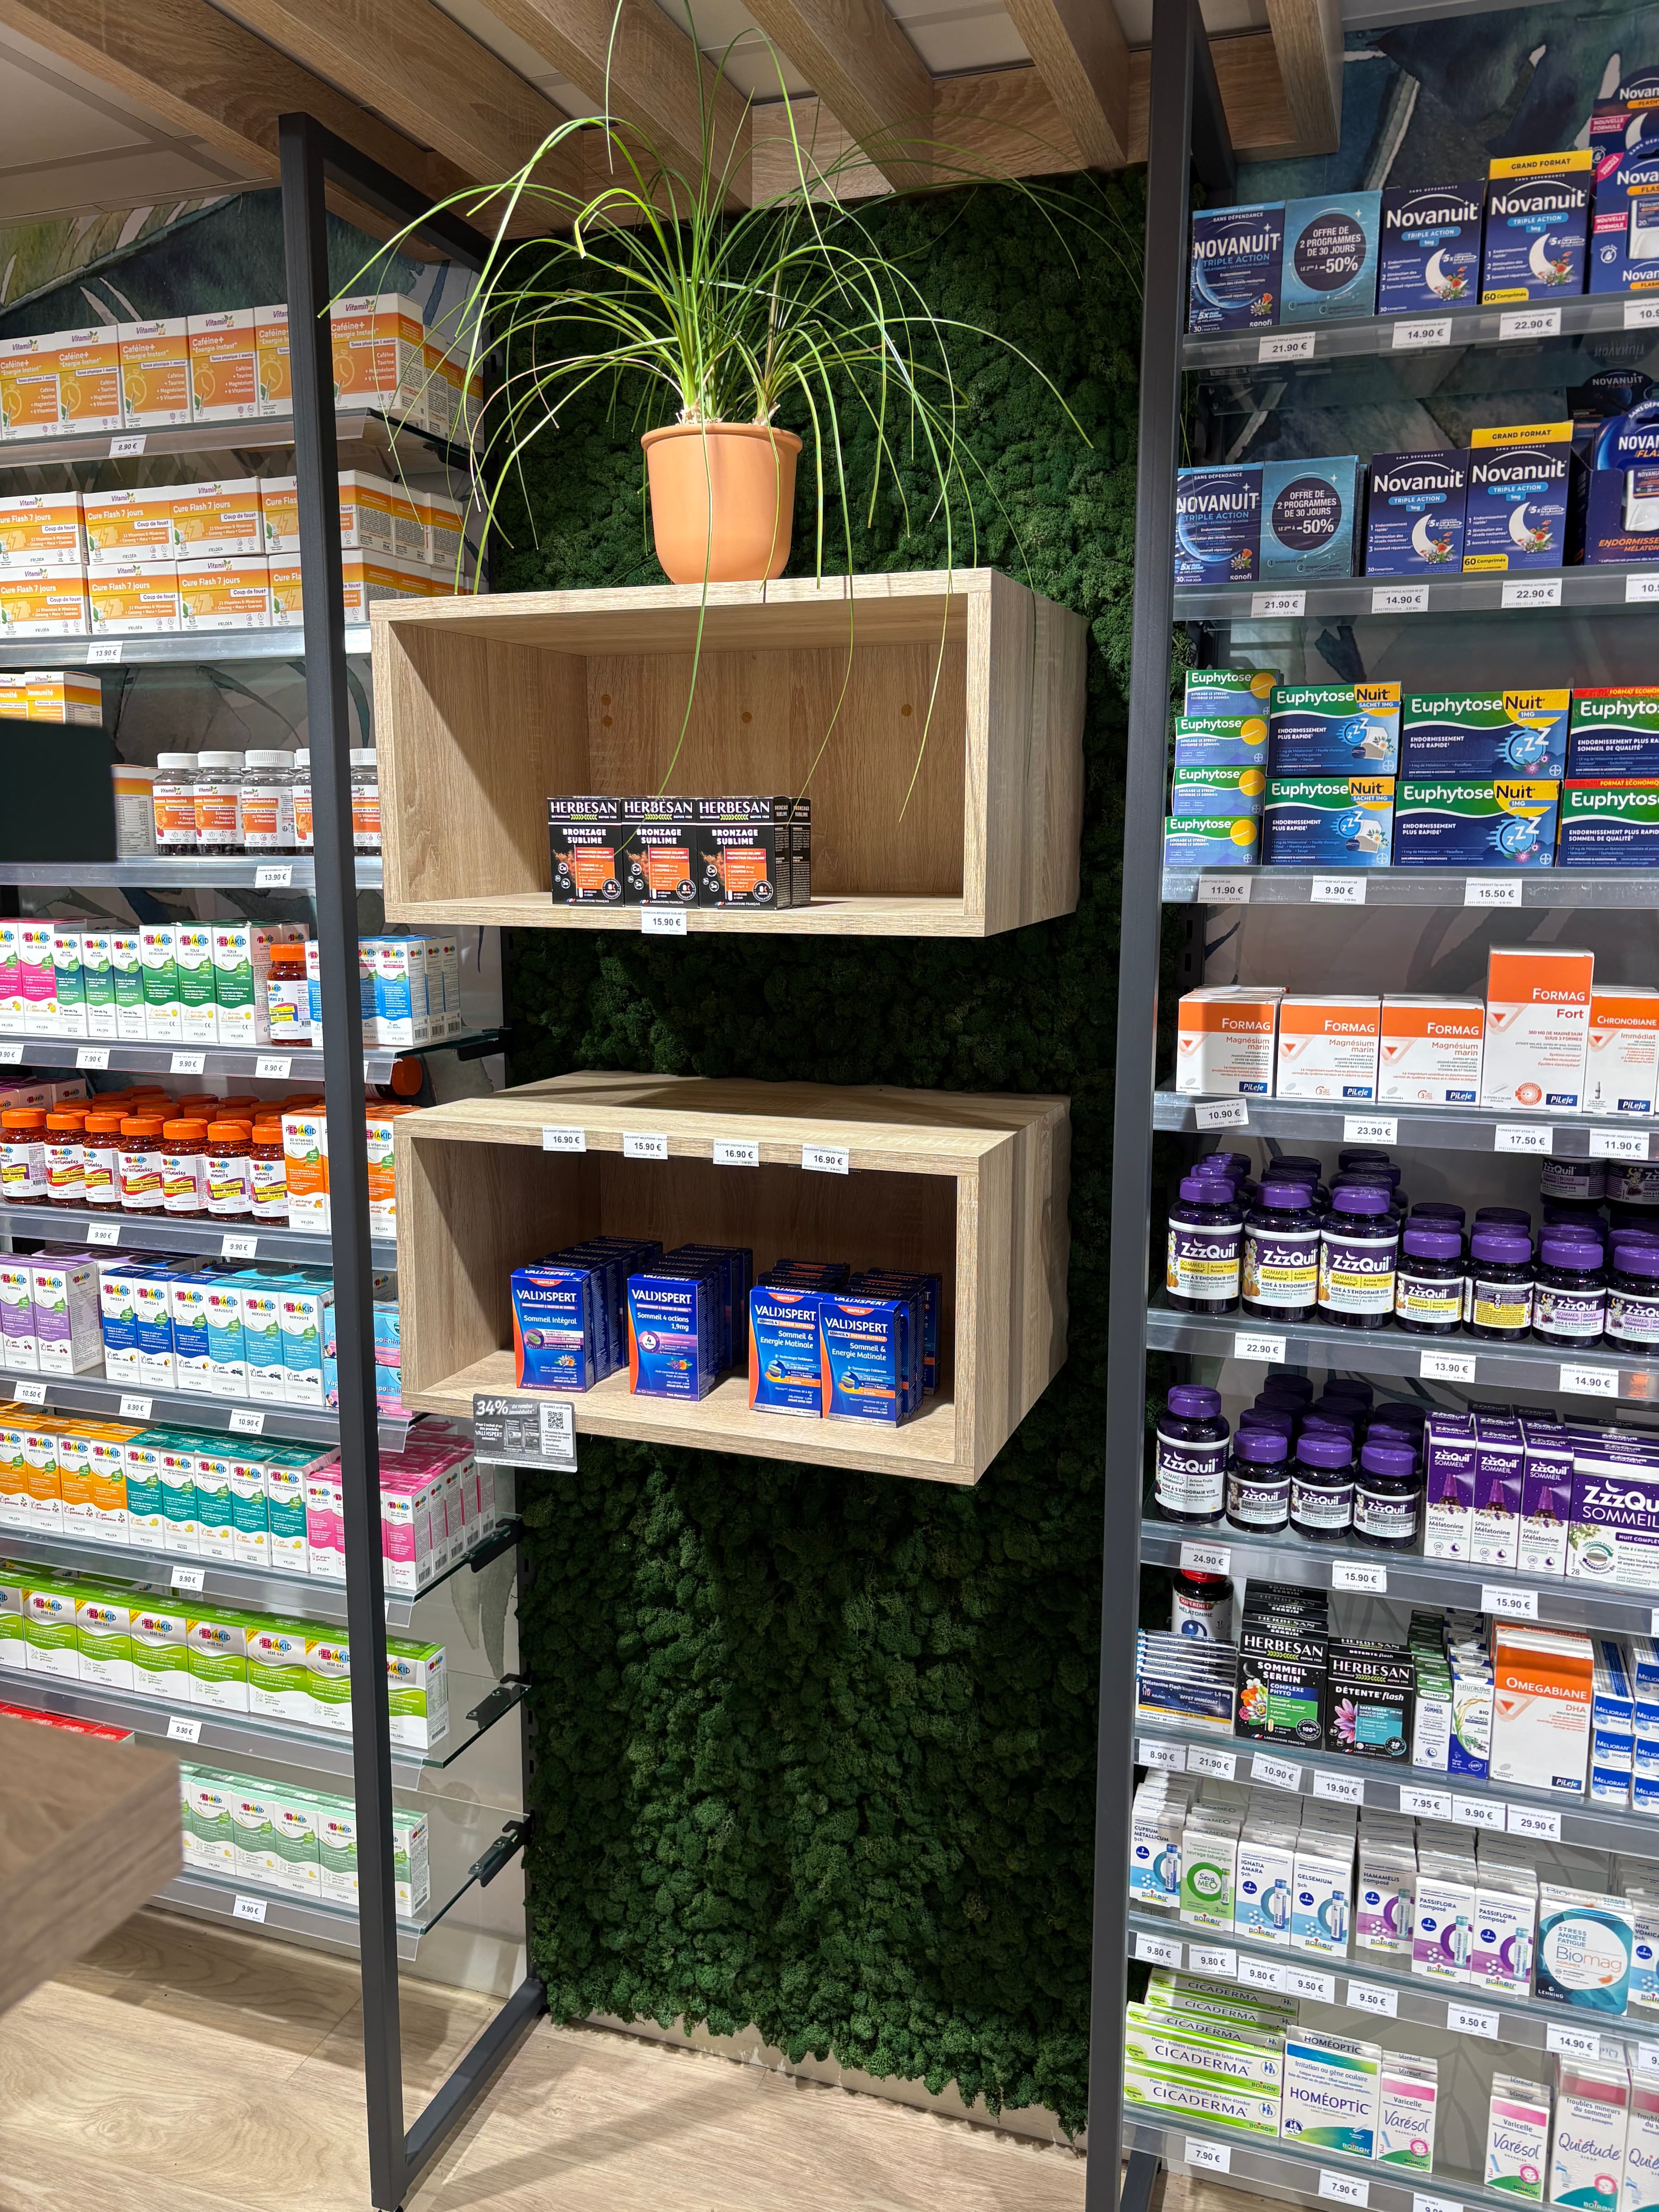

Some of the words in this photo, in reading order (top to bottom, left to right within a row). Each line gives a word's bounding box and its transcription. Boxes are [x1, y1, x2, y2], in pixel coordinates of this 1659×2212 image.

[1491, 191, 1585, 215] Novanuit
[1228, 213, 1263, 221] DÉPENDANCE
[1386, 205, 1478, 229] Novanuit
[1596, 216, 1625, 224] NOUVELLE
[1313, 228, 1337, 237] OFFRE
[1339, 226, 1349, 235] DE
[1194, 233, 1280, 259] NOVANUIT
[1307, 235, 1361, 247] PROGRAMMES
[1330, 244, 1355, 254] JOURS
[1249, 319, 1272, 327] sanofi
[1408, 330, 1434, 339] 14.90
[1437, 328, 1444, 337] €
[1272, 343, 1298, 353] 21.90
[1373, 472, 1463, 493] Novanuit
[1177, 493, 1259, 513] NOVANUIT
[104, 511, 120, 519] Flash
[127, 509, 143, 518] jours
[1516, 590, 1545, 598] 22.90
[1191, 673, 1252, 684] Euphytose
[1356, 687, 1389, 700] Nuit
[1505, 696, 1542, 710] Nuit
[699, 801, 770, 814] HERBESAN
[711, 829, 758, 837] BRONZAGE
[144, 934, 172, 945] PEDIAKID
[1533, 988, 1585, 1001] FORMAG
[1556, 1009, 1584, 1019] Fort
[1597, 1016, 1657, 1026] CHRONOBIANE
[1329, 1039, 1374, 1047] Magnésium
[286, 1125, 316, 1137] PEDIAKID
[1357, 1127, 1383, 1136] 23.90
[1385, 1128, 1391, 1136] €
[1510, 1136, 1536, 1145] 17.50
[1539, 1137, 1545, 1145] €
[1181, 1242, 1235, 1259] ZzzQuil
[516, 1289, 577, 1303] VALDISPERT
[209, 1296, 237, 1308] PEDIAKID
[524, 1315, 551, 1323] Sommeil
[553, 1316, 577, 1325] Intégral
[637, 1312, 662, 1321] Sommeil
[668, 1314, 689, 1322] actions
[671, 1323, 689, 1332] 1,9mg
[825, 1317, 888, 1334] VALDISPERT
[850, 1343, 878, 1352] Sommeil
[1247, 1344, 1270, 1353] 22.90
[832, 1348, 856, 1358] Energie
[858, 1351, 886, 1361] Matinale
[1575, 1377, 1601, 1387] 14.90
[476, 1400, 509, 1415] 34%
[1163, 1452, 1216, 1472] ZzzQuil
[1435, 1452, 1470, 1462] ZzzQuil
[1434, 1460, 1465, 1468] SOMMEIL
[1523, 1534, 1559, 1544] Mélatonine
[1193, 1555, 1216, 1564] 24.90
[1180, 1597, 1210, 1609] SUPERDIET
[1179, 1604, 1213, 1618] MÉLATONINE
[1245, 1635, 1323, 1656] HERBESAN
[1258, 1662, 1307, 1675] SOMMEIL
[1263, 1671, 1301, 1683] SEREIN
[1270, 1683, 1304, 1693] COMPLEXE
[1457, 1683, 1491, 1693] naturactive
[1506, 1677, 1587, 1700] OMEGABIANE
[1565, 1704, 1586, 1713] DHA
[1150, 1751, 1167, 1761] 8.90
[200, 1793, 222, 1804] PEDIAKID
[1135, 1825, 1158, 1834] CUPRUM
[1521, 1818, 1546, 1830] 29.90
[1135, 1831, 1169, 1842] METALLICUM
[1241, 1860, 1265, 1869] IGNATIA
[1298, 1874, 1332, 1885] GELSEMIUM
[1364, 1872, 1399, 1882] HAMAMELIS
[1479, 1908, 1516, 1920] PASSIFLORA
[1479, 1914, 1506, 1923] composé
[1194, 1914, 1220, 1926] BOIRON
[1558, 1926, 1586, 1936] STRESS
[1558, 1932, 1586, 1941] ANXIÉTÉ
[1557, 1937, 1586, 1947] FATIGUE
[1201, 1957, 1218, 1965] 9.80
[1220, 1958, 1226, 1966] €
[1557, 1946, 1621, 1972] Biomag
[1538, 1990, 1564, 1999] LEHNING
[1560, 2037, 1586, 2048] 14.90
[1588, 2042, 1593, 2050] €
[1155, 2045, 1249, 2076] CICADERMA
[1394, 2096, 1422, 2108] Varicelle
[1567, 2097, 1592, 2108] Troubles
[1594, 2105, 1620, 2115] mineurs
[1584, 2107, 1611, 2119] sommeil
[1385, 2110, 1430, 2134] Varésol
[1558, 2132, 1620, 2161] Quiétude
[1196, 2150, 1212, 2161] 7.90
